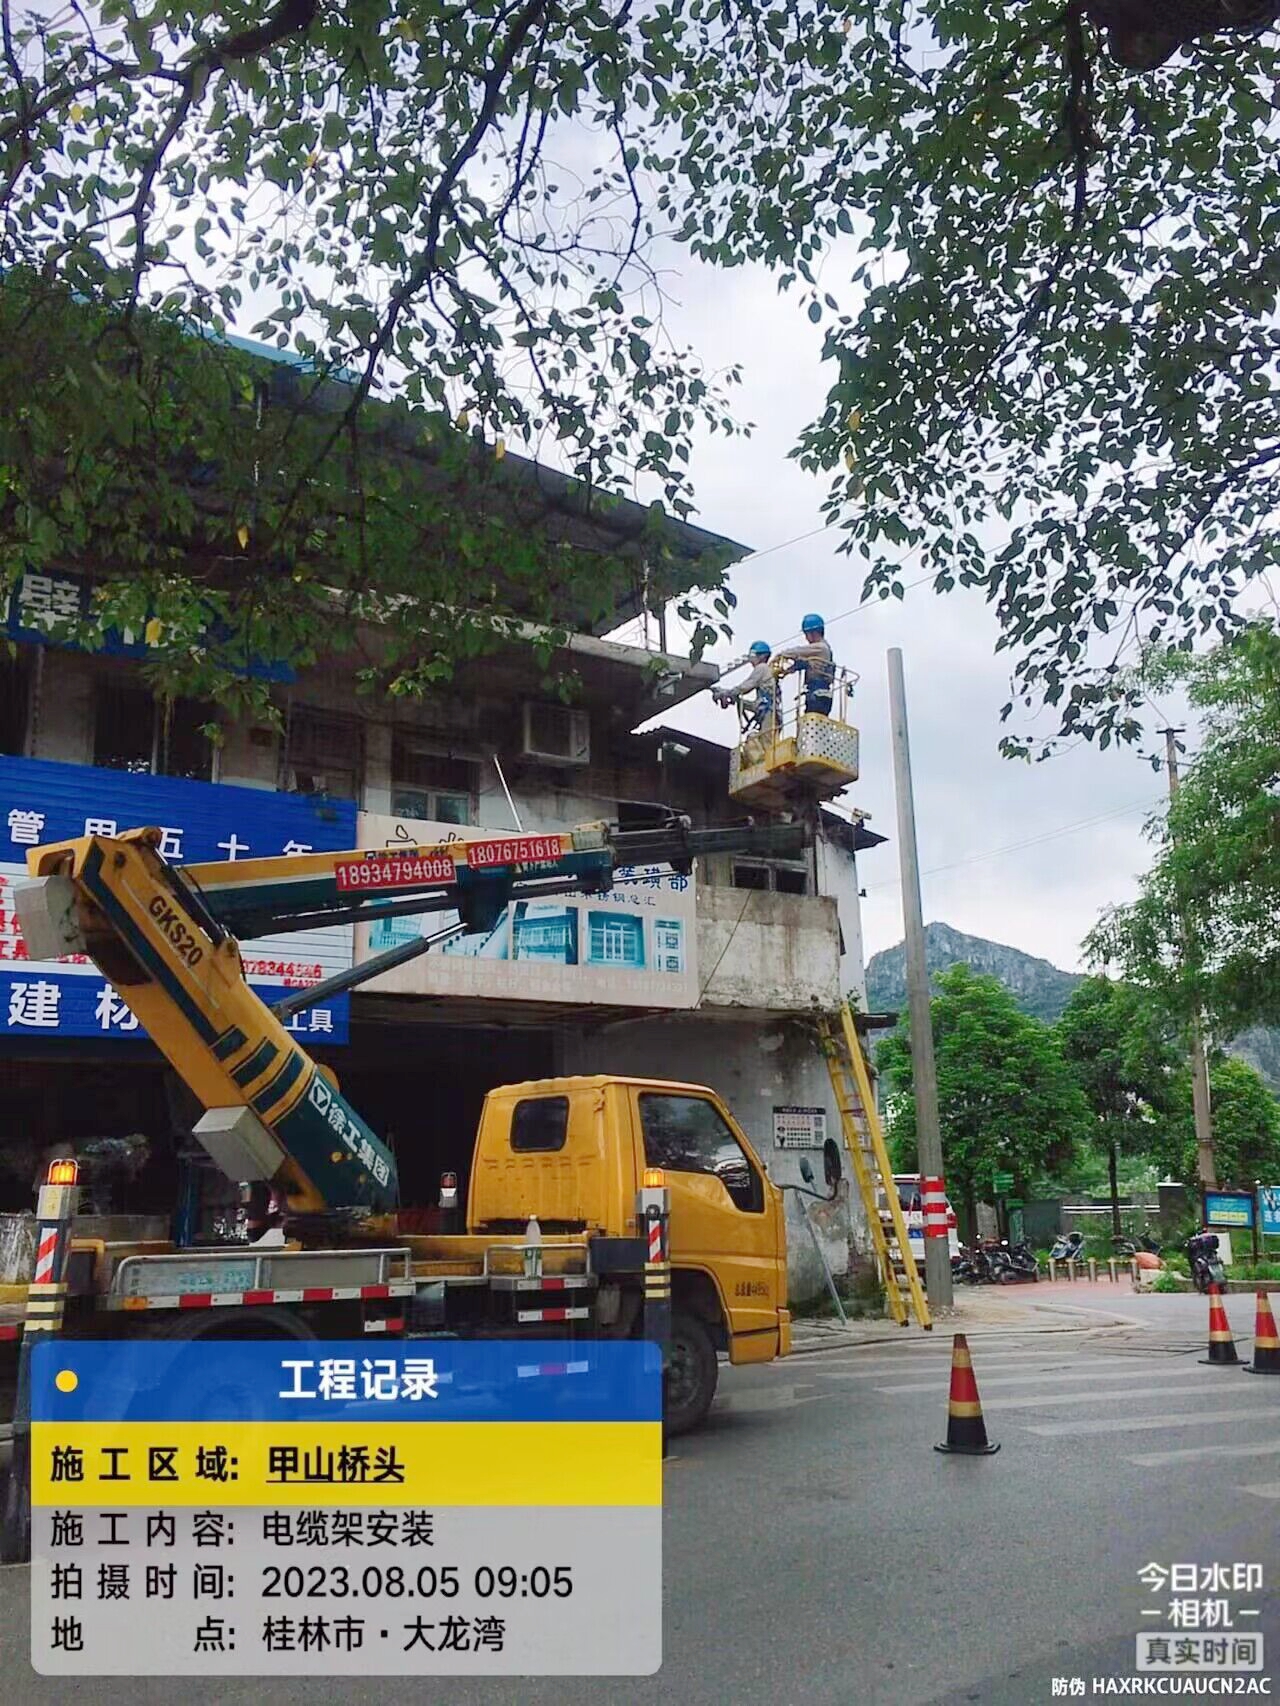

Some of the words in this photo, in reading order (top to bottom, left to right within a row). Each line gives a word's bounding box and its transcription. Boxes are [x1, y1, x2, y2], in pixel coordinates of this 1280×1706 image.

[470, 839, 560, 864] 18076751618
[338, 859, 452, 886] 18934794008
[148, 895, 203, 966] GKS20
